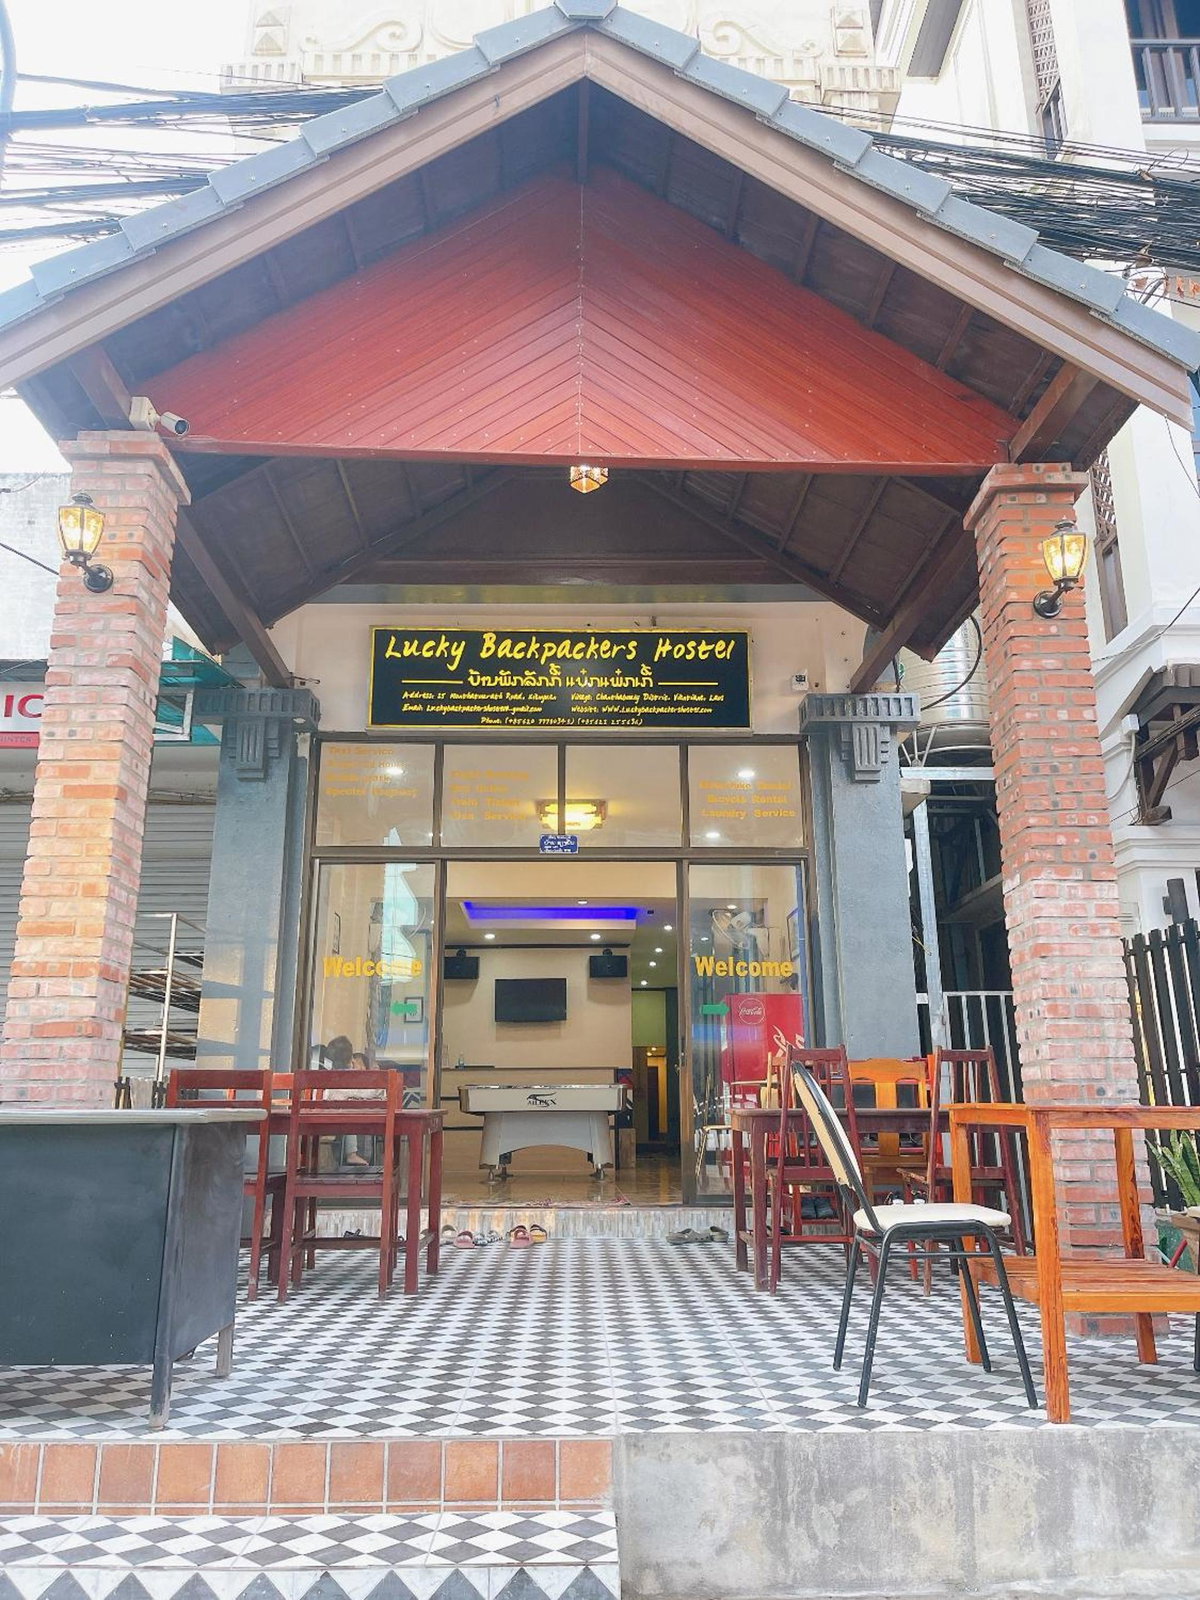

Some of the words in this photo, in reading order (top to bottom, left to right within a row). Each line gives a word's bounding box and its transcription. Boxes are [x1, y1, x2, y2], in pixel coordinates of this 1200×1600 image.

[385, 635, 466, 671] Lucky
[480, 632, 638, 665] Backpackers
[654, 638, 736, 662] Hostel
[695, 955, 794, 977] Welcome
